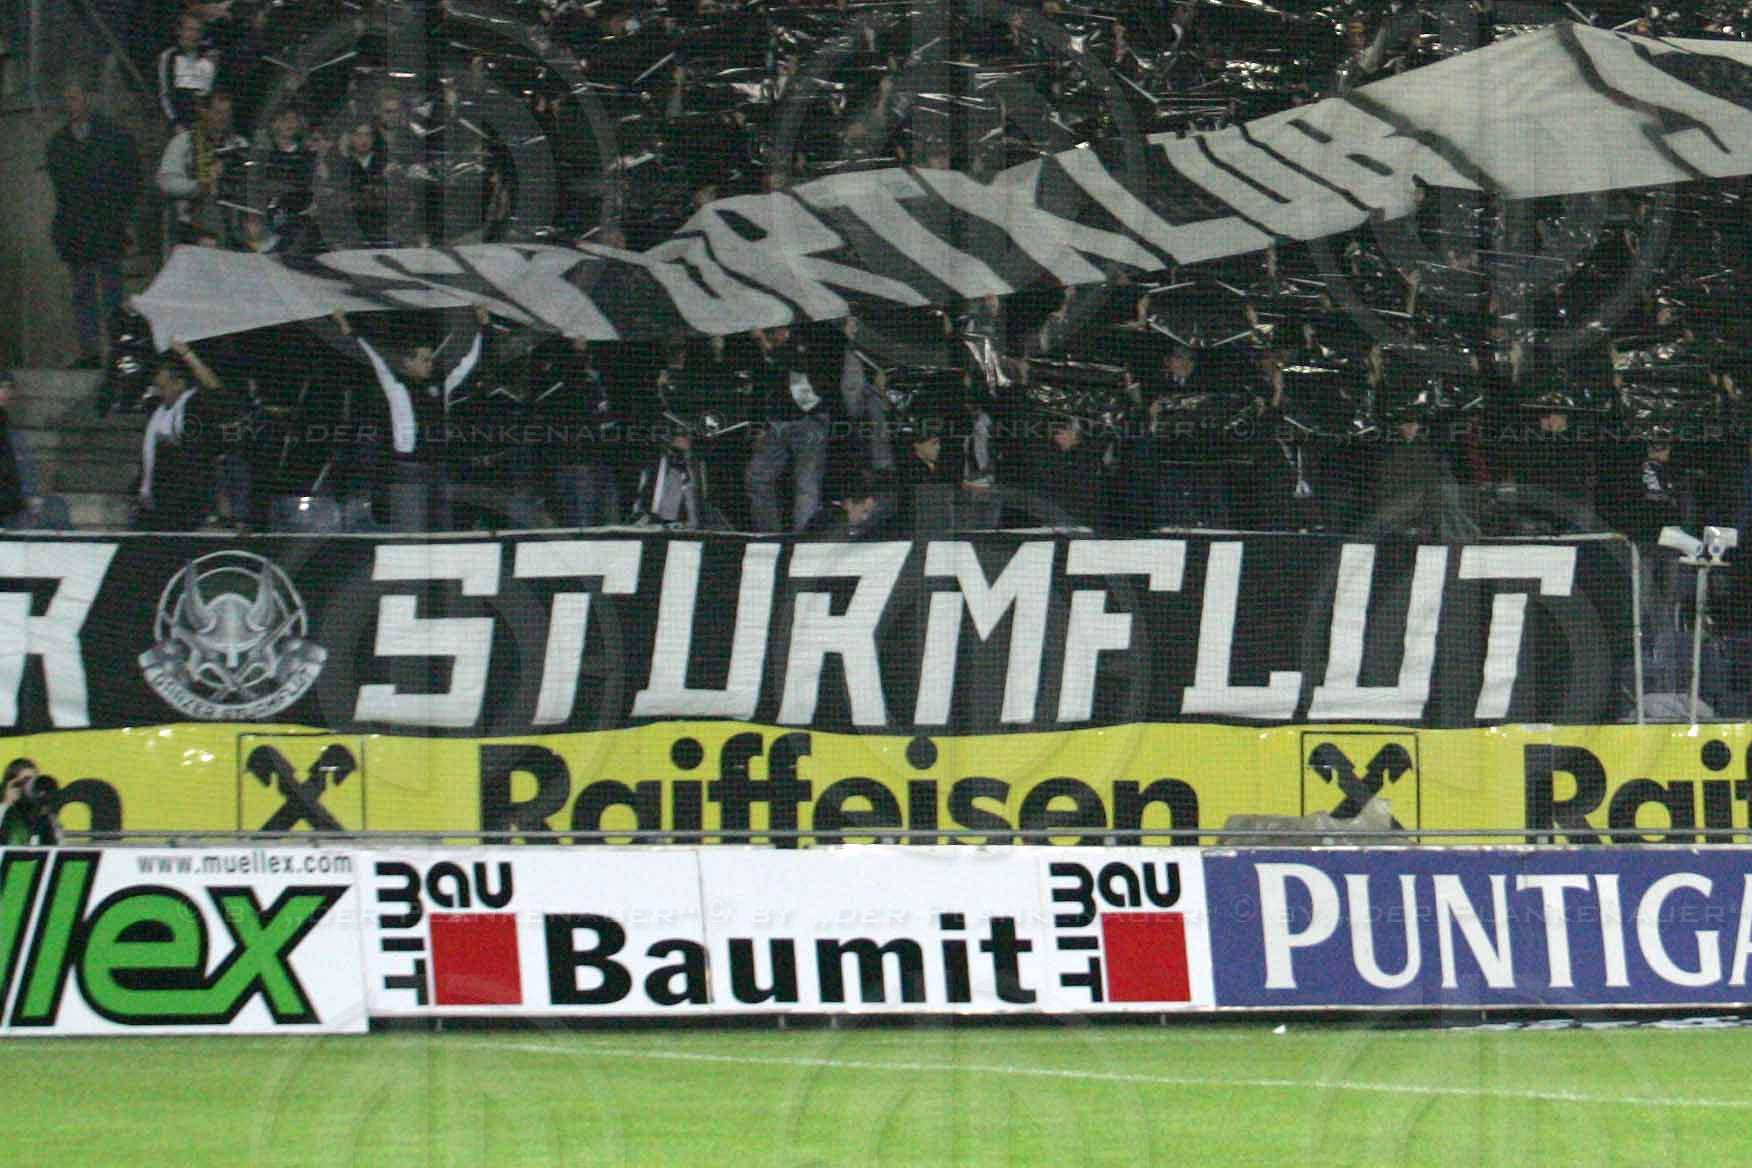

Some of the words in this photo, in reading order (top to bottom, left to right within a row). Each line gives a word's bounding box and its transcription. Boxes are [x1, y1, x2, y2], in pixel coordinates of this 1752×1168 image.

[353, 540, 1577, 728] STURMFLUT
[480, 733, 1200, 845] Raiffeisen
[137, 854, 353, 874] www.muellex.com
[543, 911, 1037, 1007] Baumit
